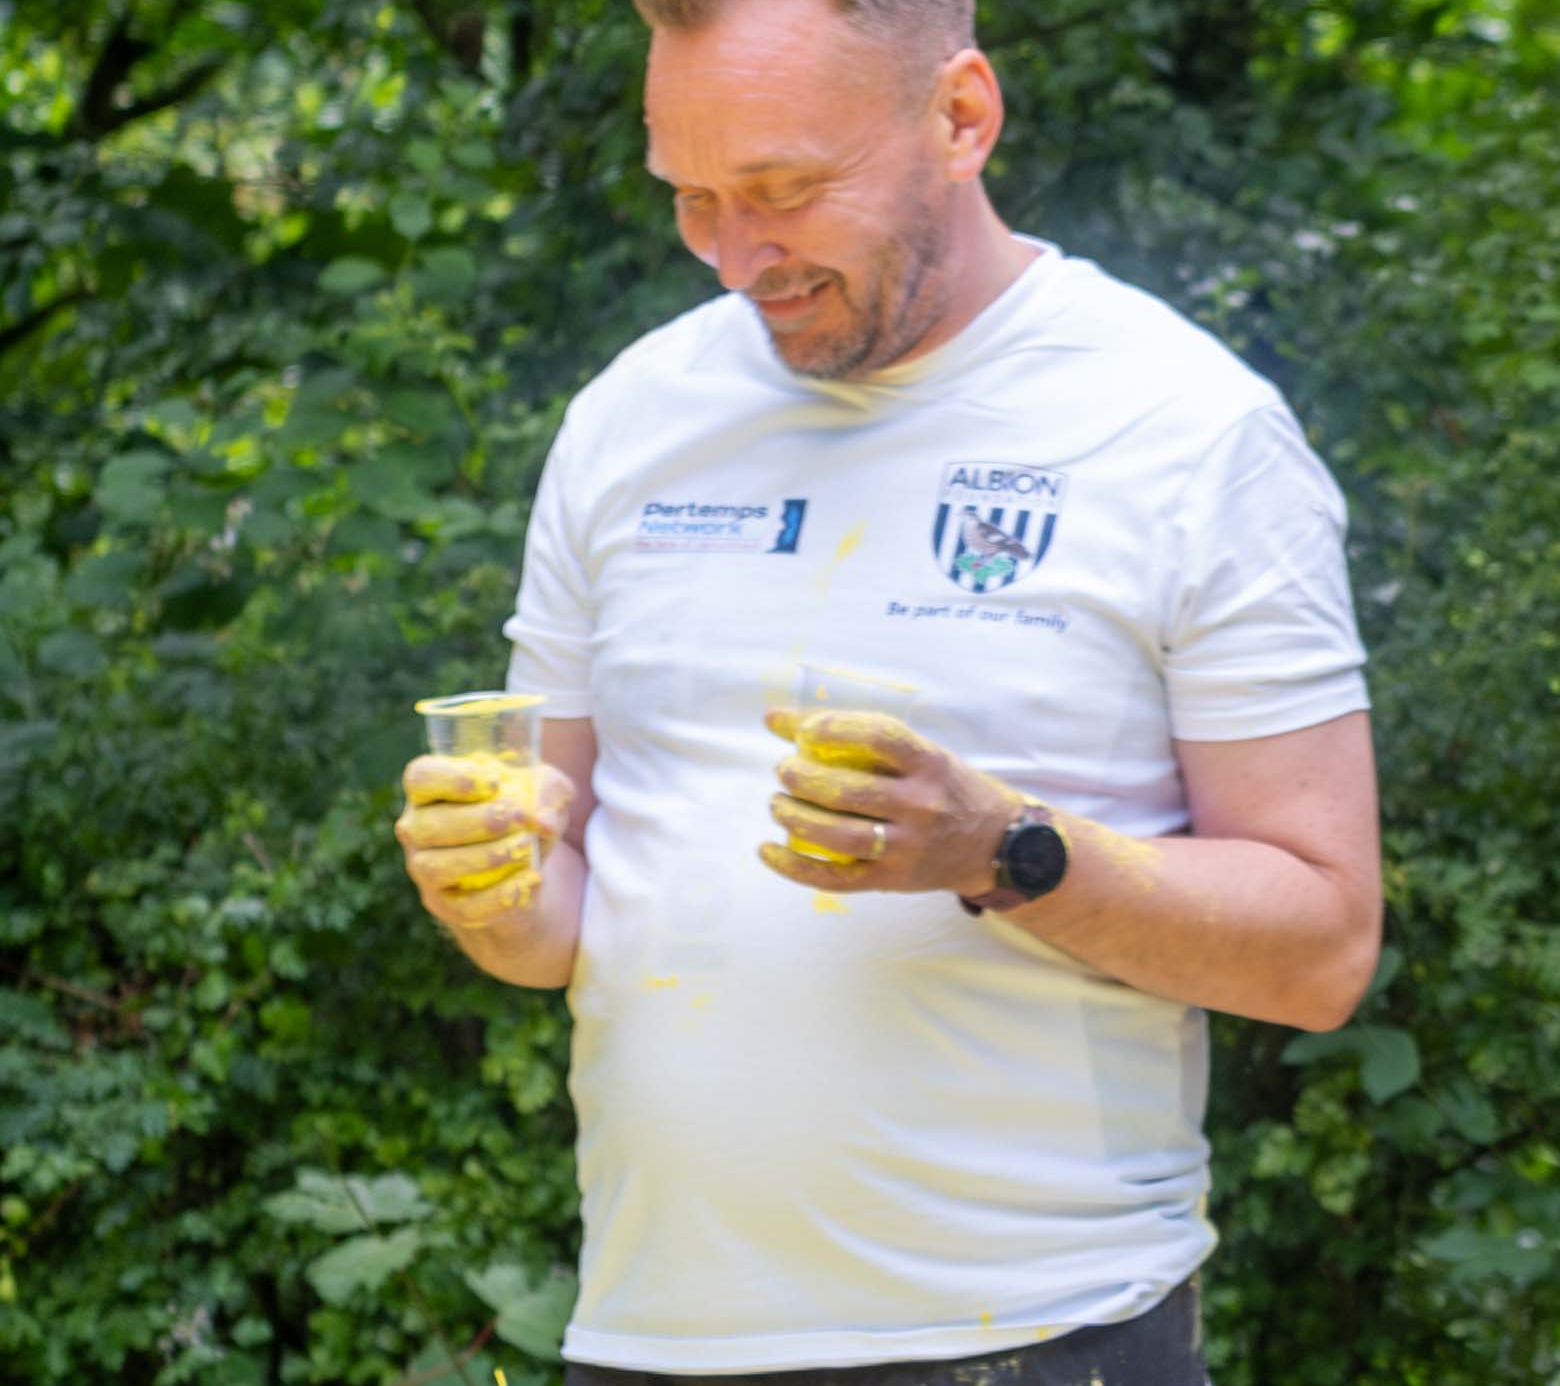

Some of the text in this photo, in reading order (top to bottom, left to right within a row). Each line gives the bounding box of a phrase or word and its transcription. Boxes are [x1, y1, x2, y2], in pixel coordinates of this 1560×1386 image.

[949, 468, 1062, 496] ALBION
[886, 601, 1070, 633] Be part of our family
